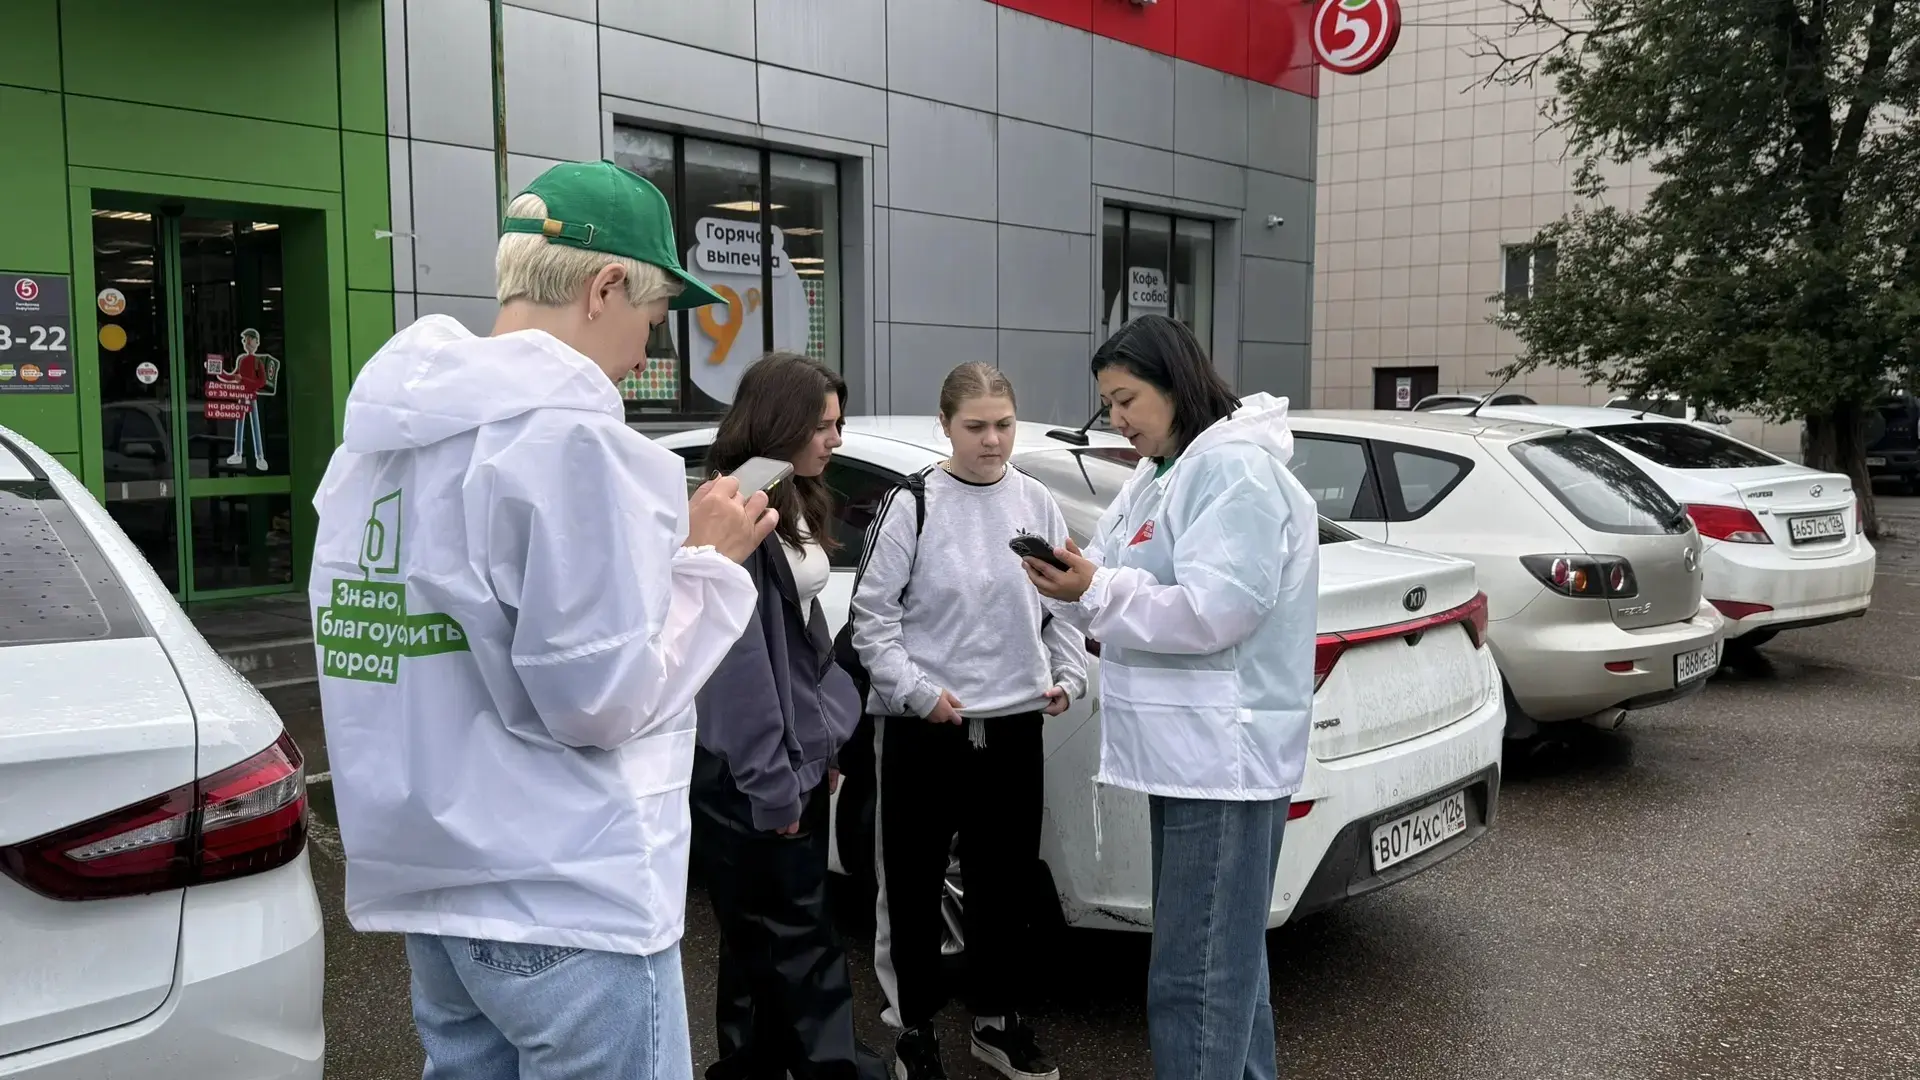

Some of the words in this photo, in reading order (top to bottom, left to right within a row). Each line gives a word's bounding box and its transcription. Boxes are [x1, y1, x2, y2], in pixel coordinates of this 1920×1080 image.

[707, 249, 780, 268] выпеча
[1133, 271, 1158, 288] Кофе
[21, 280, 33, 297] 5
[1133, 291, 1138, 301] с
[208, 381, 245, 391] Доставка
[229, 392, 254, 400] минут
[220, 403, 250, 412] работу
[214, 411, 241, 419] домой
[336, 582, 401, 616] Знаю,
[327, 649, 394, 679] город
[1379, 814, 1441, 863] В074ХС
[1442, 796, 1463, 825] 126
[1447, 822, 1458, 834] RUS
